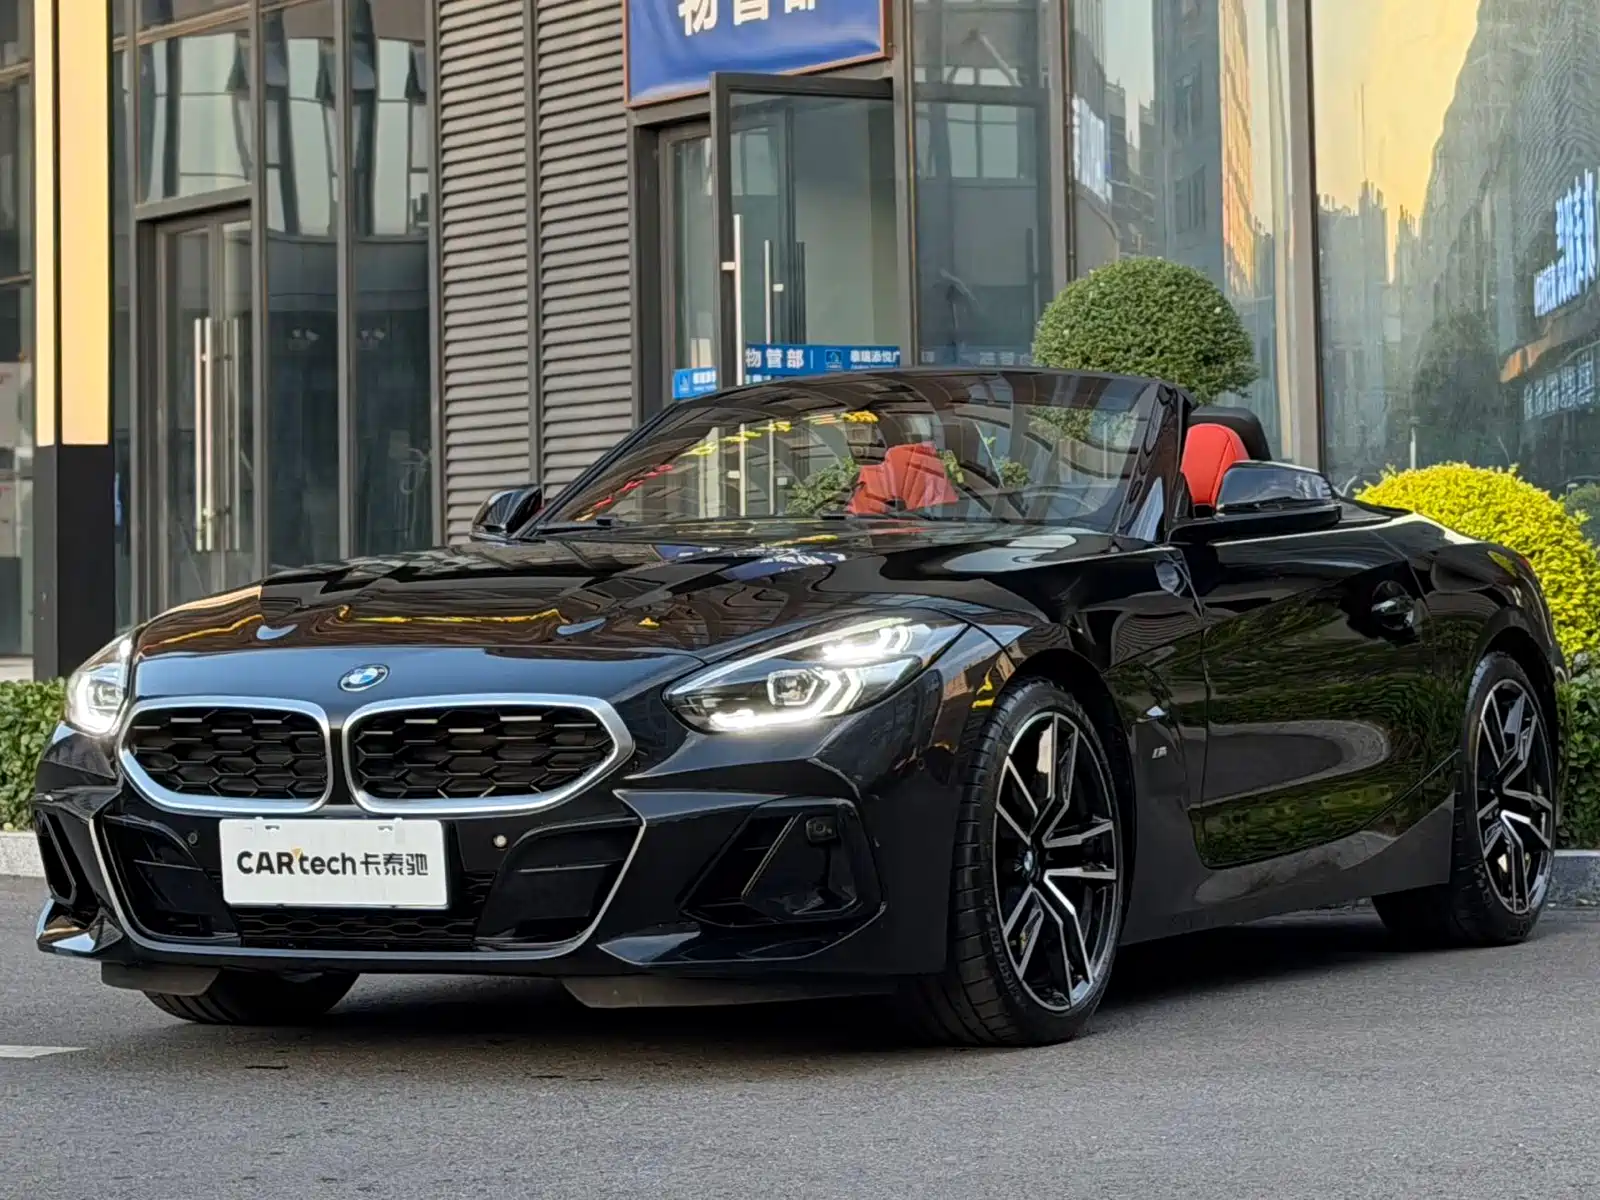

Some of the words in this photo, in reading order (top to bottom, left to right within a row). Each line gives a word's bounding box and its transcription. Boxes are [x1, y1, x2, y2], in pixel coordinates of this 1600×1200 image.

[746, 348, 804, 369] 物管部
[236, 850, 357, 875] CARtech
[360, 852, 428, 876] 卡泰驰
